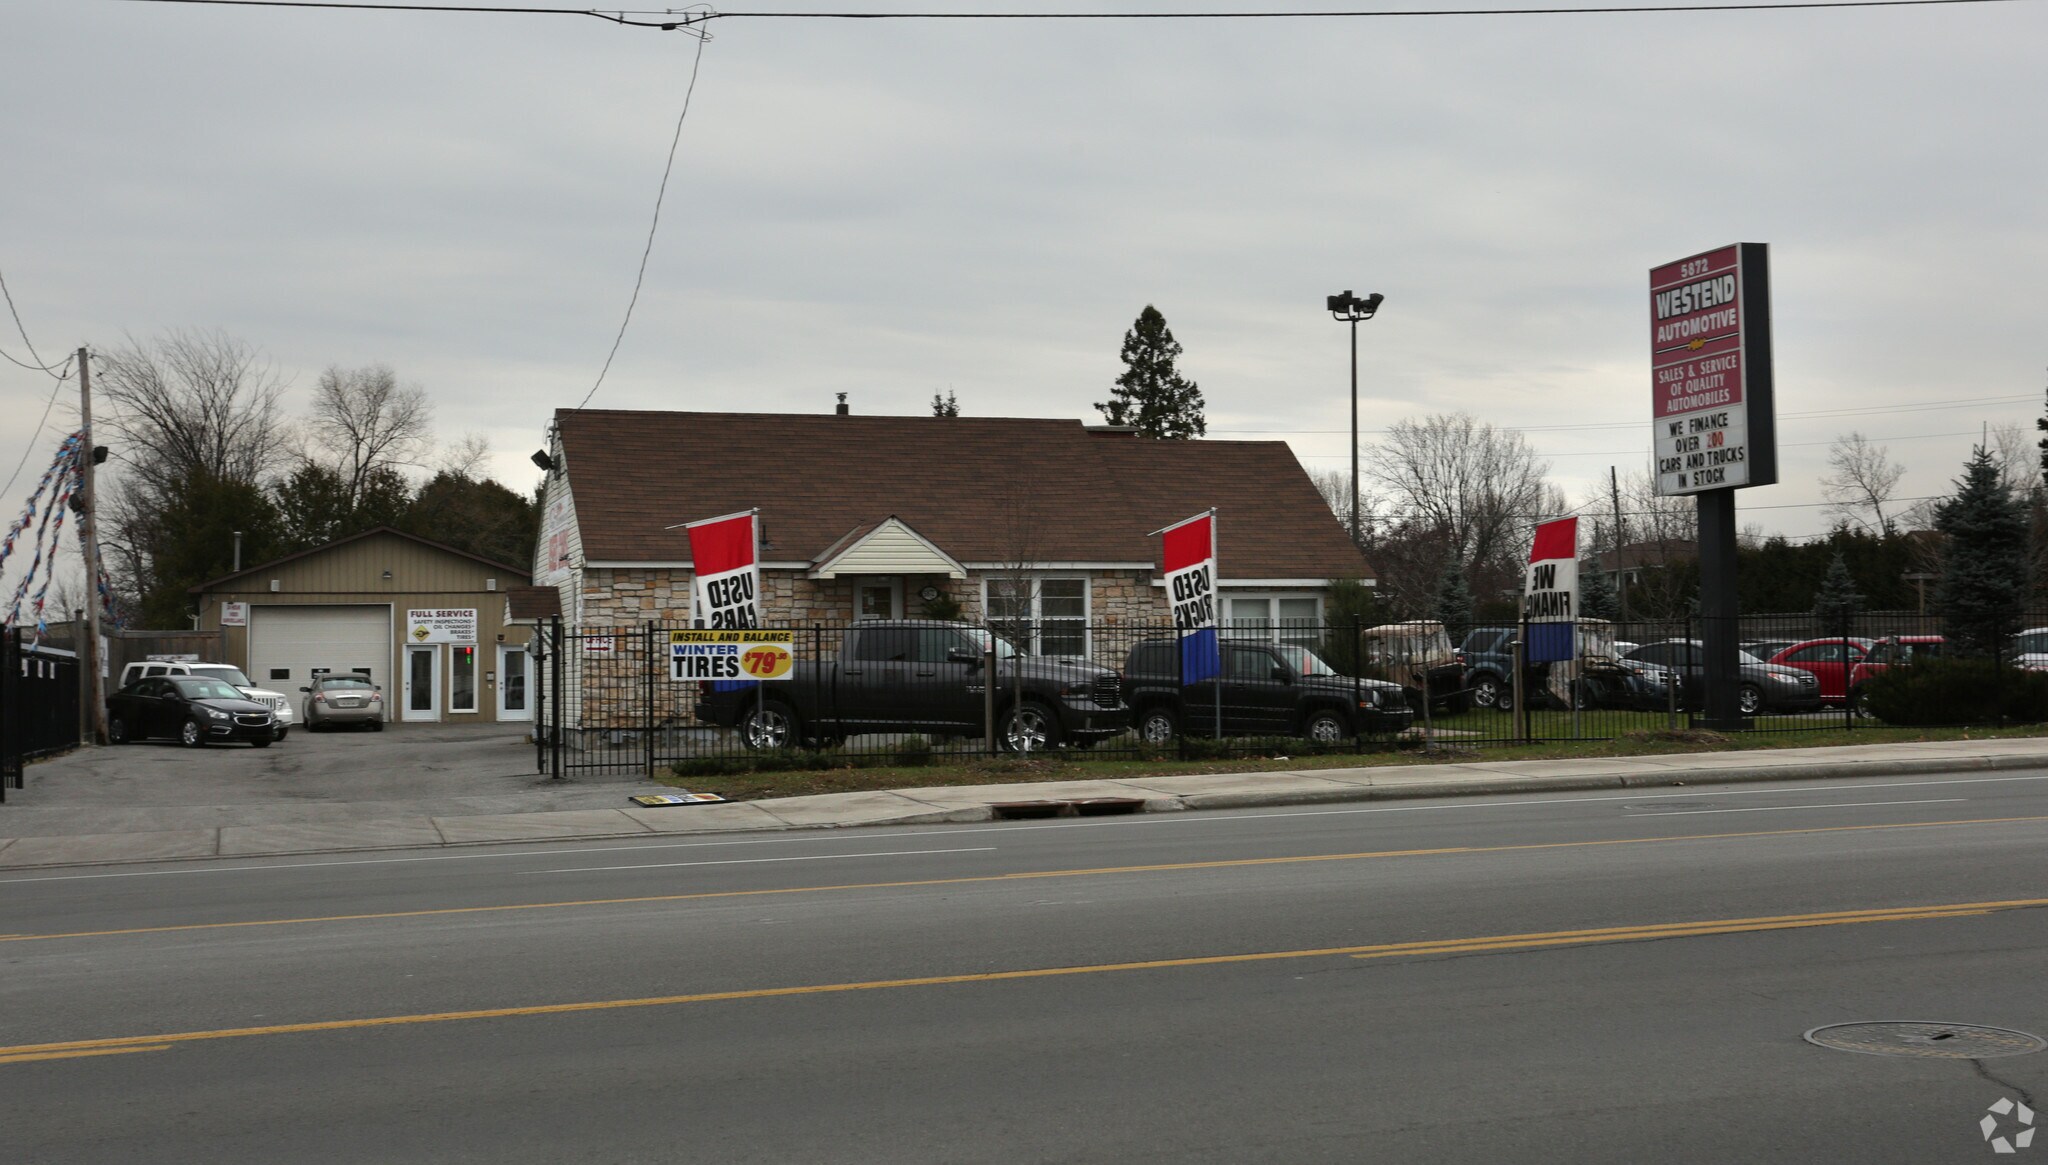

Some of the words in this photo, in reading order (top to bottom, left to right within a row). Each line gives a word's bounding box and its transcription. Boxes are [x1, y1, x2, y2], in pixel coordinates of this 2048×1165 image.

[1681, 258, 1708, 278] 5872
[1656, 273, 1735, 320] WESTEND
[1657, 308, 1736, 343] AUTOMOTIVE
[1658, 366, 1684, 384] SALES
[1688, 364, 1695, 377] &
[1700, 355, 1737, 374] SERVICE
[1670, 382, 1682, 396] OF
[1686, 373, 1725, 393] QUALITY
[1666, 388, 1730, 412] AUTOMOBILES
[1669, 421, 1683, 436] WE
[1689, 412, 1728, 433] FINANCE
[1675, 436, 1699, 453] OVER
[1707, 431, 1724, 449] 200
[1660, 456, 1682, 473] CARS
[1686, 452, 1704, 469] AND
[1707, 446, 1744, 465] TRUCKS
[1678, 474, 1687, 488] IN
[1694, 467, 1725, 485] STOCK
[672, 633, 714, 641] INSTALL
[717, 633, 740, 641] AND
[743, 633, 790, 641] BALANCE
[673, 645, 738, 655] WINTER
[673, 656, 739, 677] TIRES
